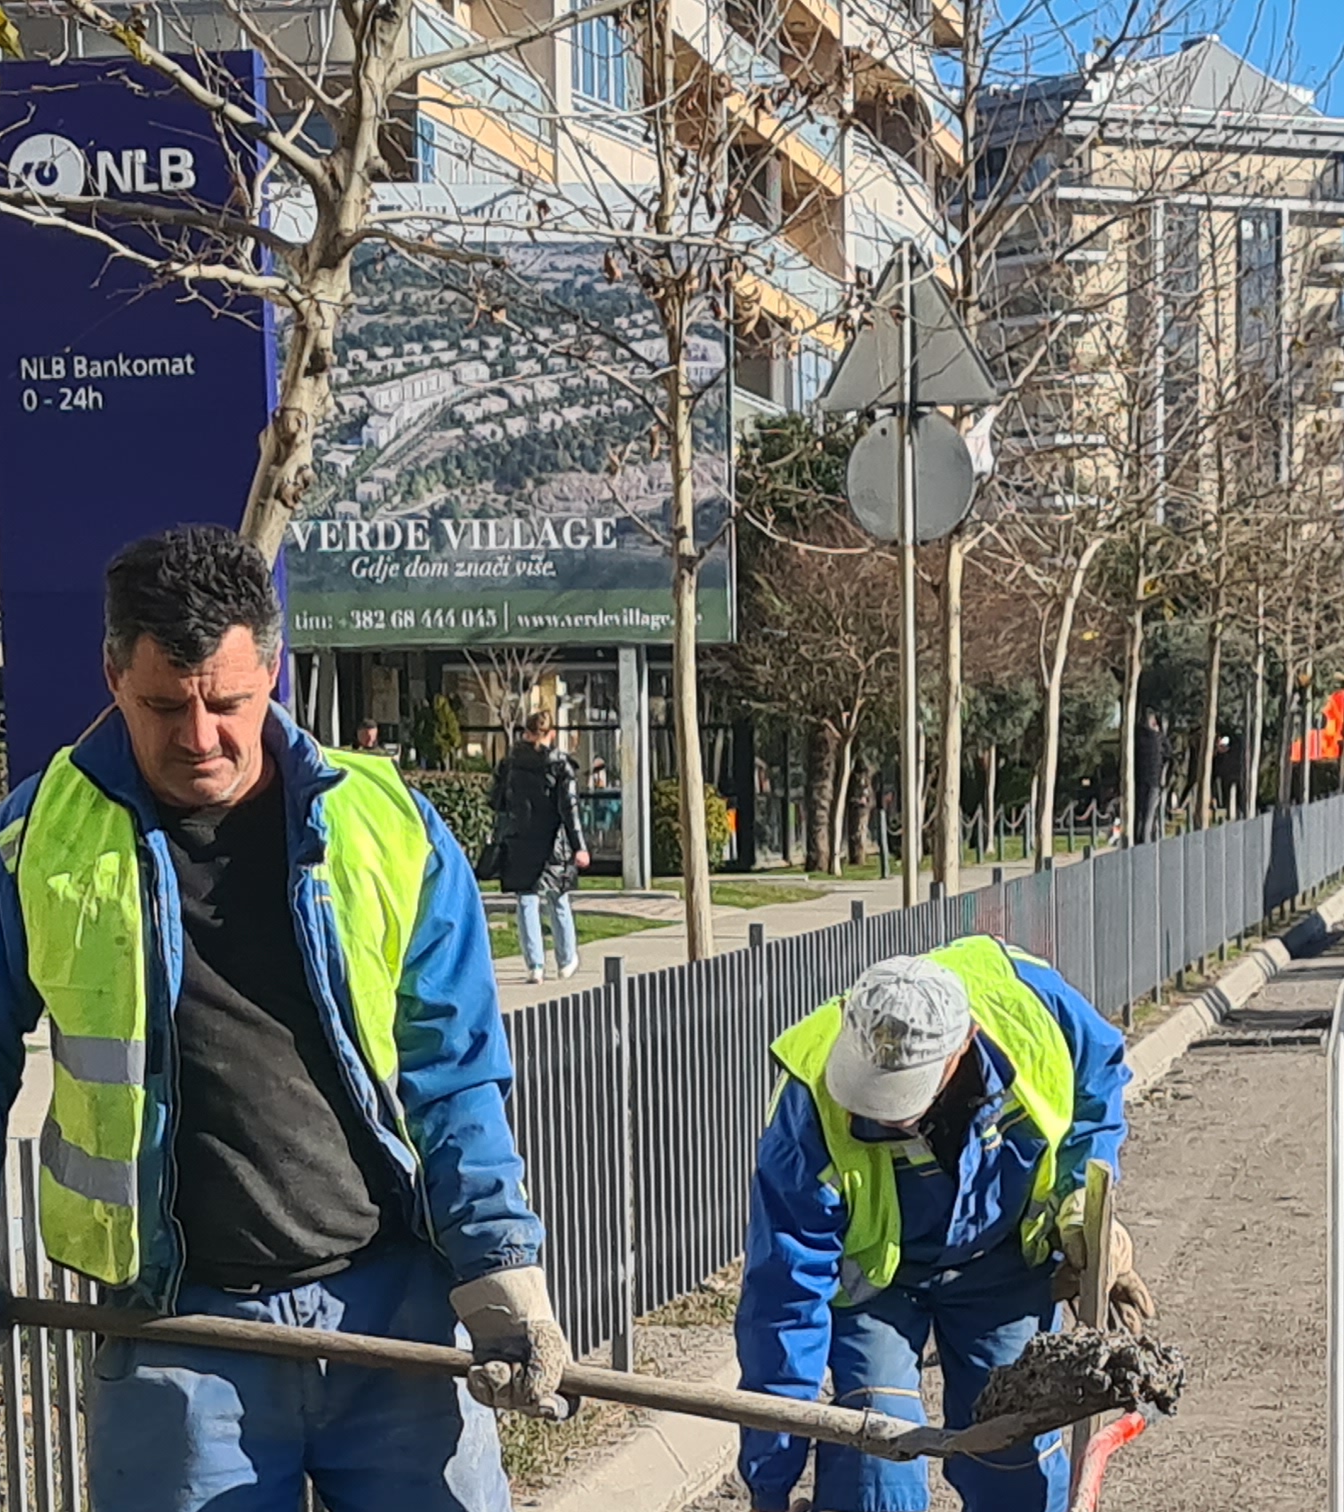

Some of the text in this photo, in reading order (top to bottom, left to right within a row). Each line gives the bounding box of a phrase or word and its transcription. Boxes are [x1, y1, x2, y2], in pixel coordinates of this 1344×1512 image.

[97, 147, 196, 195] NLB
[20, 353, 196, 381] NLB Bankomat
[22, 388, 38, 412] 0
[59, 385, 103, 411] 24h
[288, 516, 617, 552] VERDE VILLAGE
[351, 555, 400, 584] Gdje
[404, 554, 449, 578] dom
[453, 554, 511, 577] znači
[390, 608, 416, 630] 68
[421, 607, 456, 630] 444
[460, 607, 497, 630] 045
